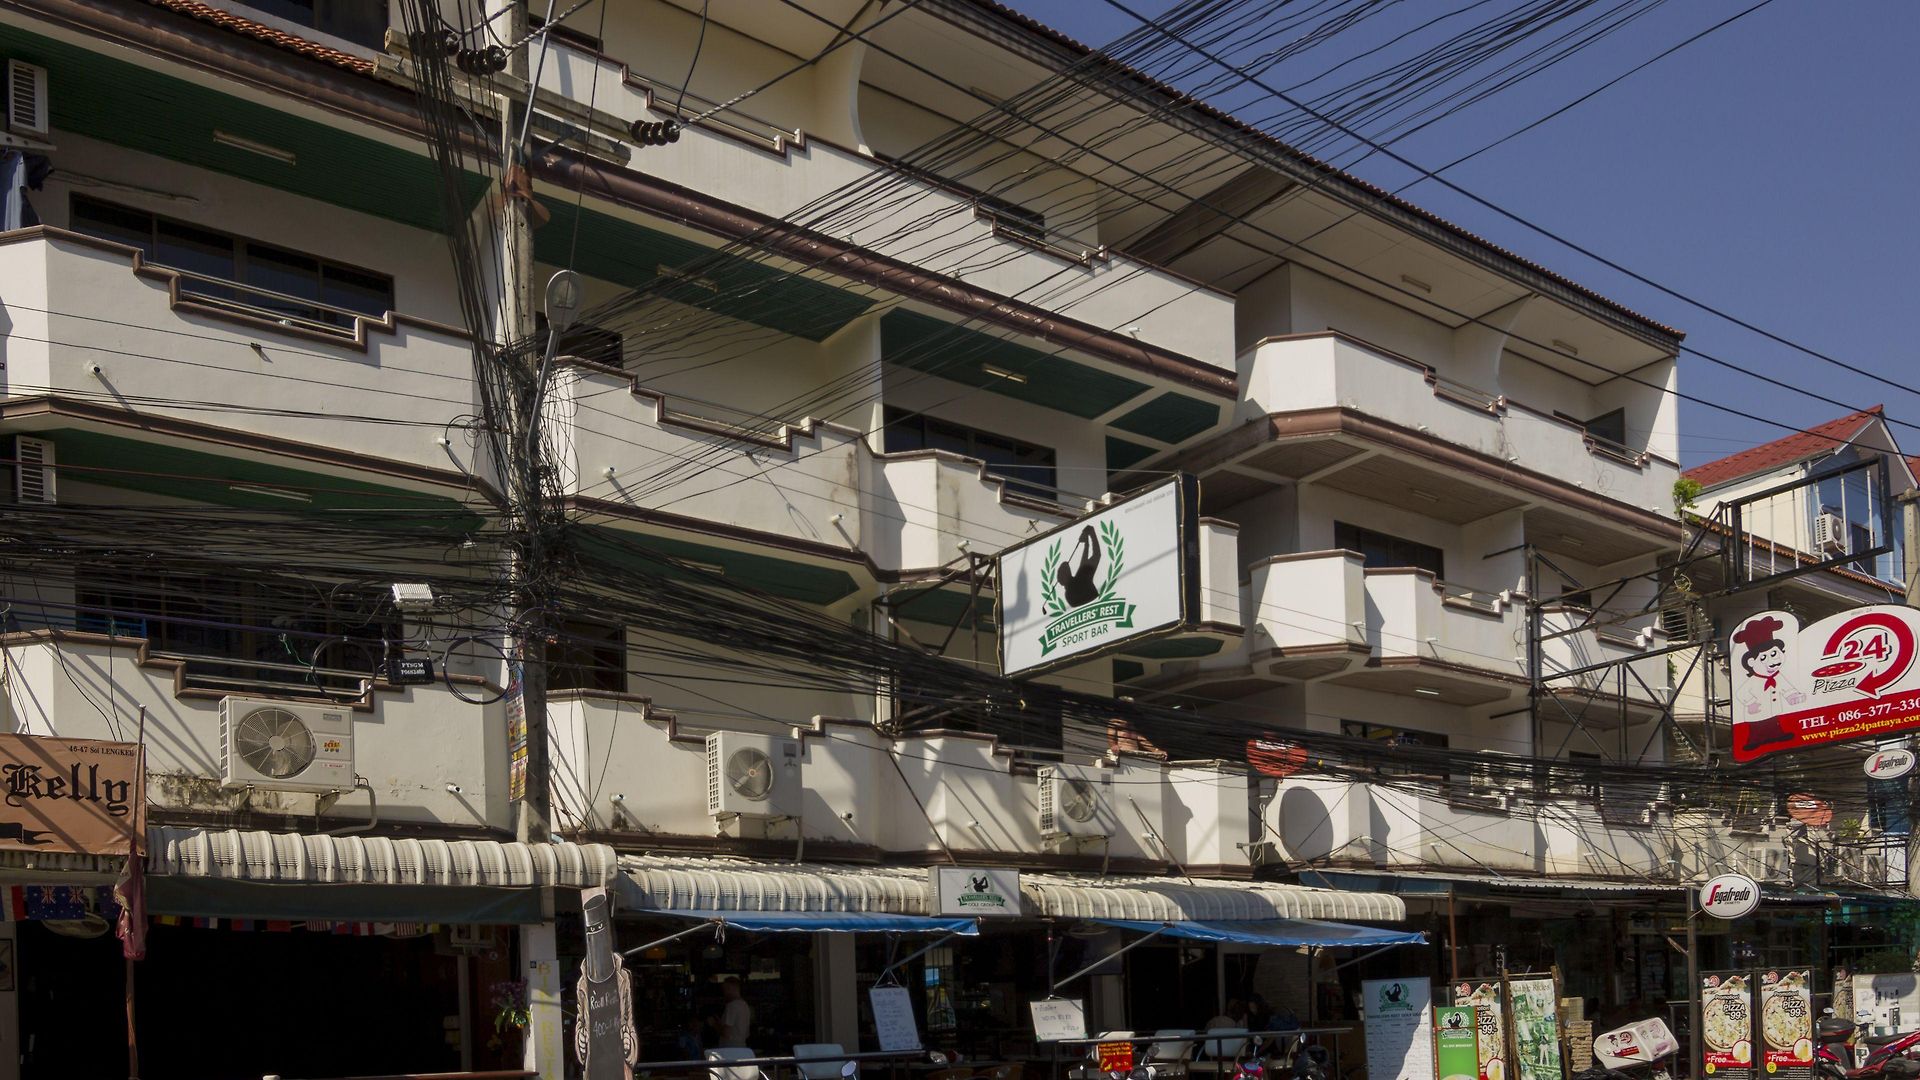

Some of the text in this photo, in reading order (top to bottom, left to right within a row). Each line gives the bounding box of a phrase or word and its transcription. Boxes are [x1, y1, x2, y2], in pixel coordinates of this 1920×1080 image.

[1100, 604, 1120, 617] REST
[1062, 624, 1109, 648] SPORT BAR
[1843, 634, 1889, 661] 24
[1812, 677, 1856, 695] Pizza
[1870, 754, 1908, 773] Segafredo
[2, 762, 131, 817] Kelly
[1705, 884, 1751, 907] Segafredo
